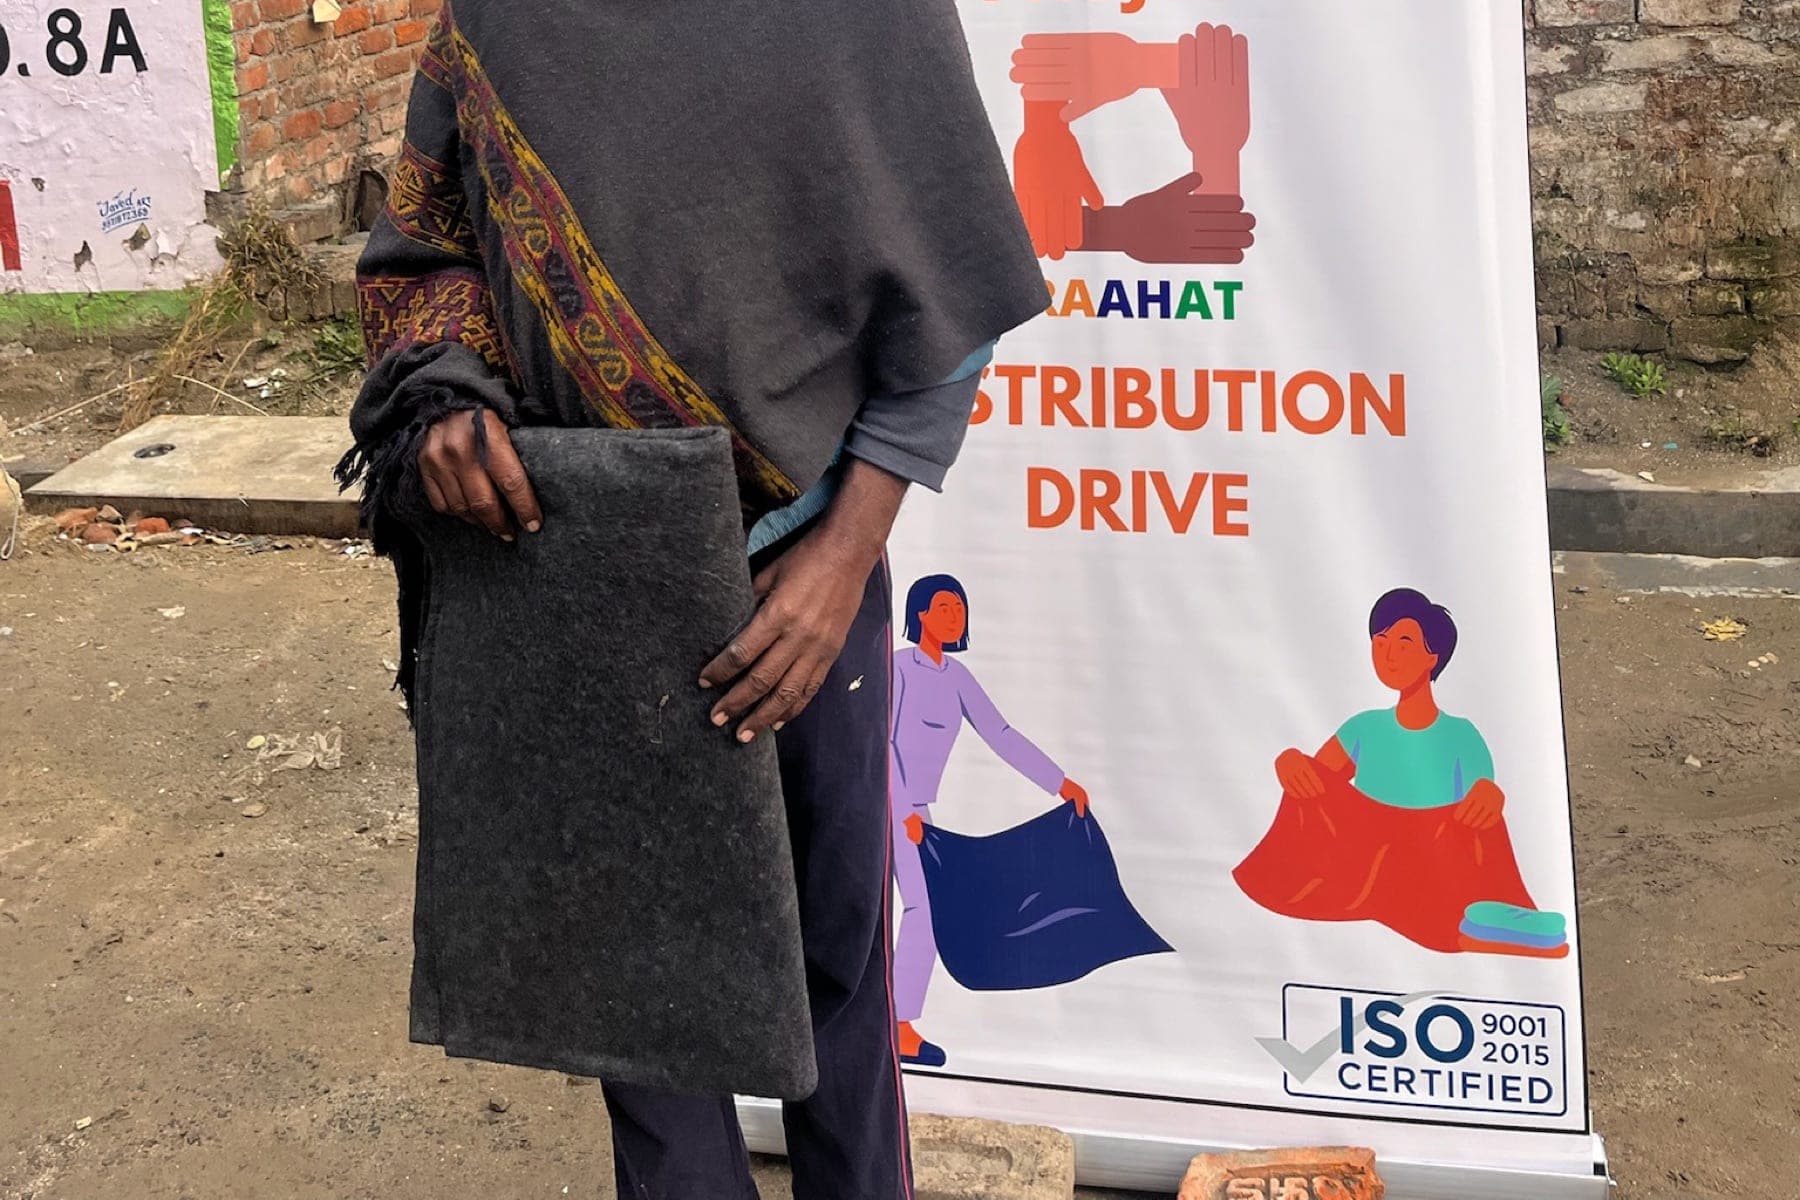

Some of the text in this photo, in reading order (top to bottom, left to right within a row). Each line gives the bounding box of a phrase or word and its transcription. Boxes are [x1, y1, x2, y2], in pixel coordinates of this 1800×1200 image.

[1027, 467, 1249, 536] DRIVE
[1340, 996, 1547, 1064] ISO 9001
[1482, 1042, 1549, 1067] 2015
[1337, 1062, 1554, 1105] CERTIFIED
